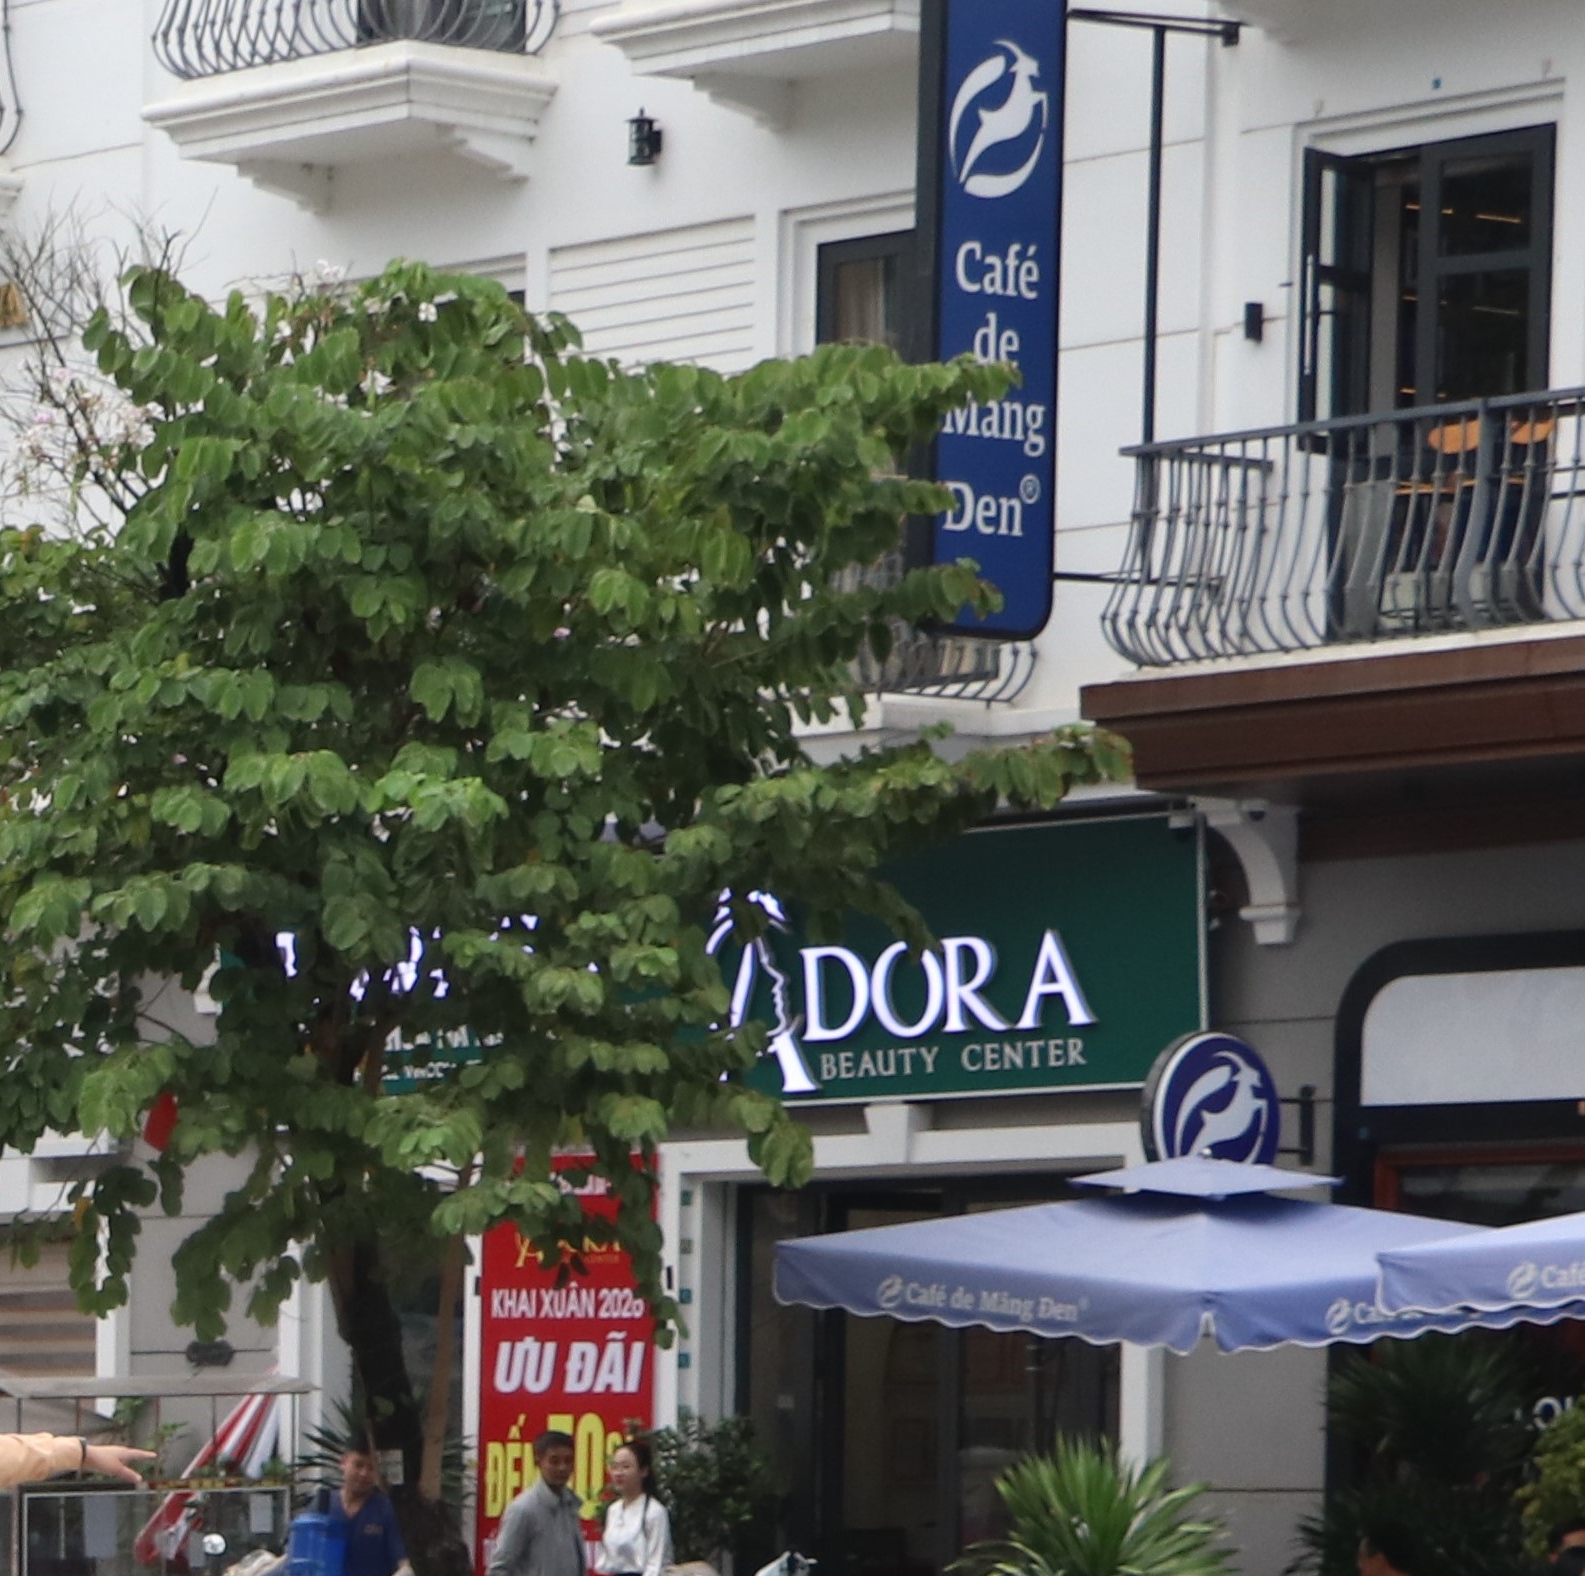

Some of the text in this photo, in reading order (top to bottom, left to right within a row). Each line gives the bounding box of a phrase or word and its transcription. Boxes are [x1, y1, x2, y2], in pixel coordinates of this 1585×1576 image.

[955, 240, 1039, 299] Café
[973, 312, 1020, 366] de
[820, 1037, 1087, 1081] BEAUTY CENTER
[491, 1288, 537, 1319] KHAI
[540, 1282, 595, 1319] XUÂN
[905, 1283, 948, 1307] Café
[950, 1286, 976, 1309] de
[493, 1331, 646, 1394] ƯU ĐÃI
